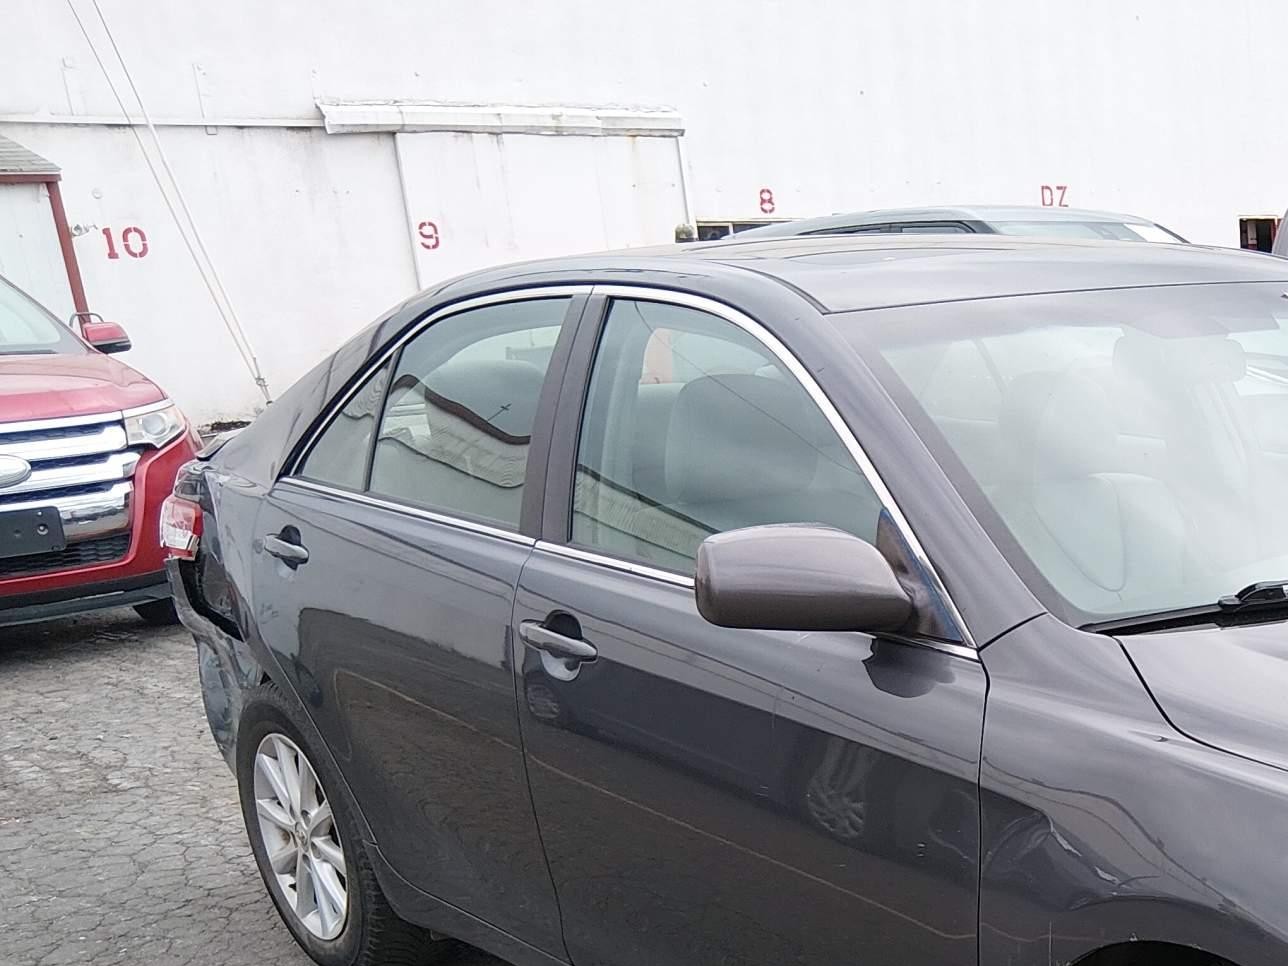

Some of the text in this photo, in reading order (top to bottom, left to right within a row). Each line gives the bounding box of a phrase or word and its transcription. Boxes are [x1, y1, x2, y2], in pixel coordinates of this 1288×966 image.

[759, 188, 775, 214] 8
[102, 226, 149, 260] 10
[418, 221, 440, 250] 9
